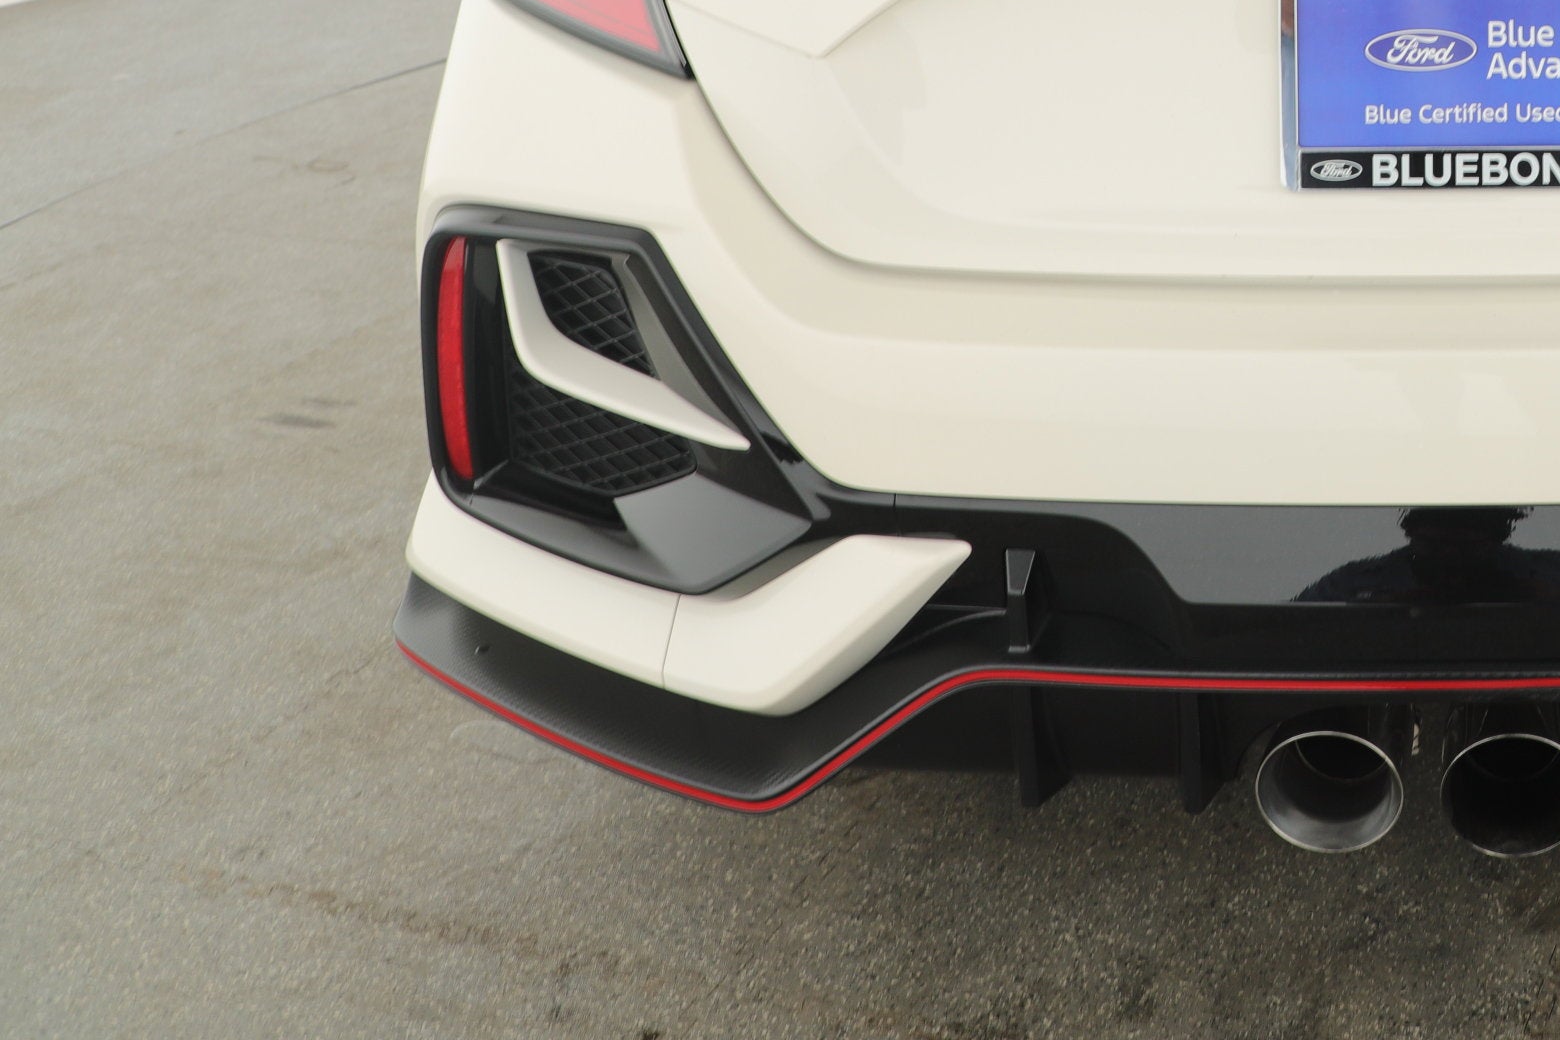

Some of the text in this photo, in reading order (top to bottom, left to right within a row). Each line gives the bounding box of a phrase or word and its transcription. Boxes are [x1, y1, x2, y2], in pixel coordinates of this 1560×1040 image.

[1486, 18, 1556, 48] Blue
[1386, 33, 1456, 65] Ford
[1364, 104, 1412, 125] Blue
[1418, 102, 1509, 125] Certified
